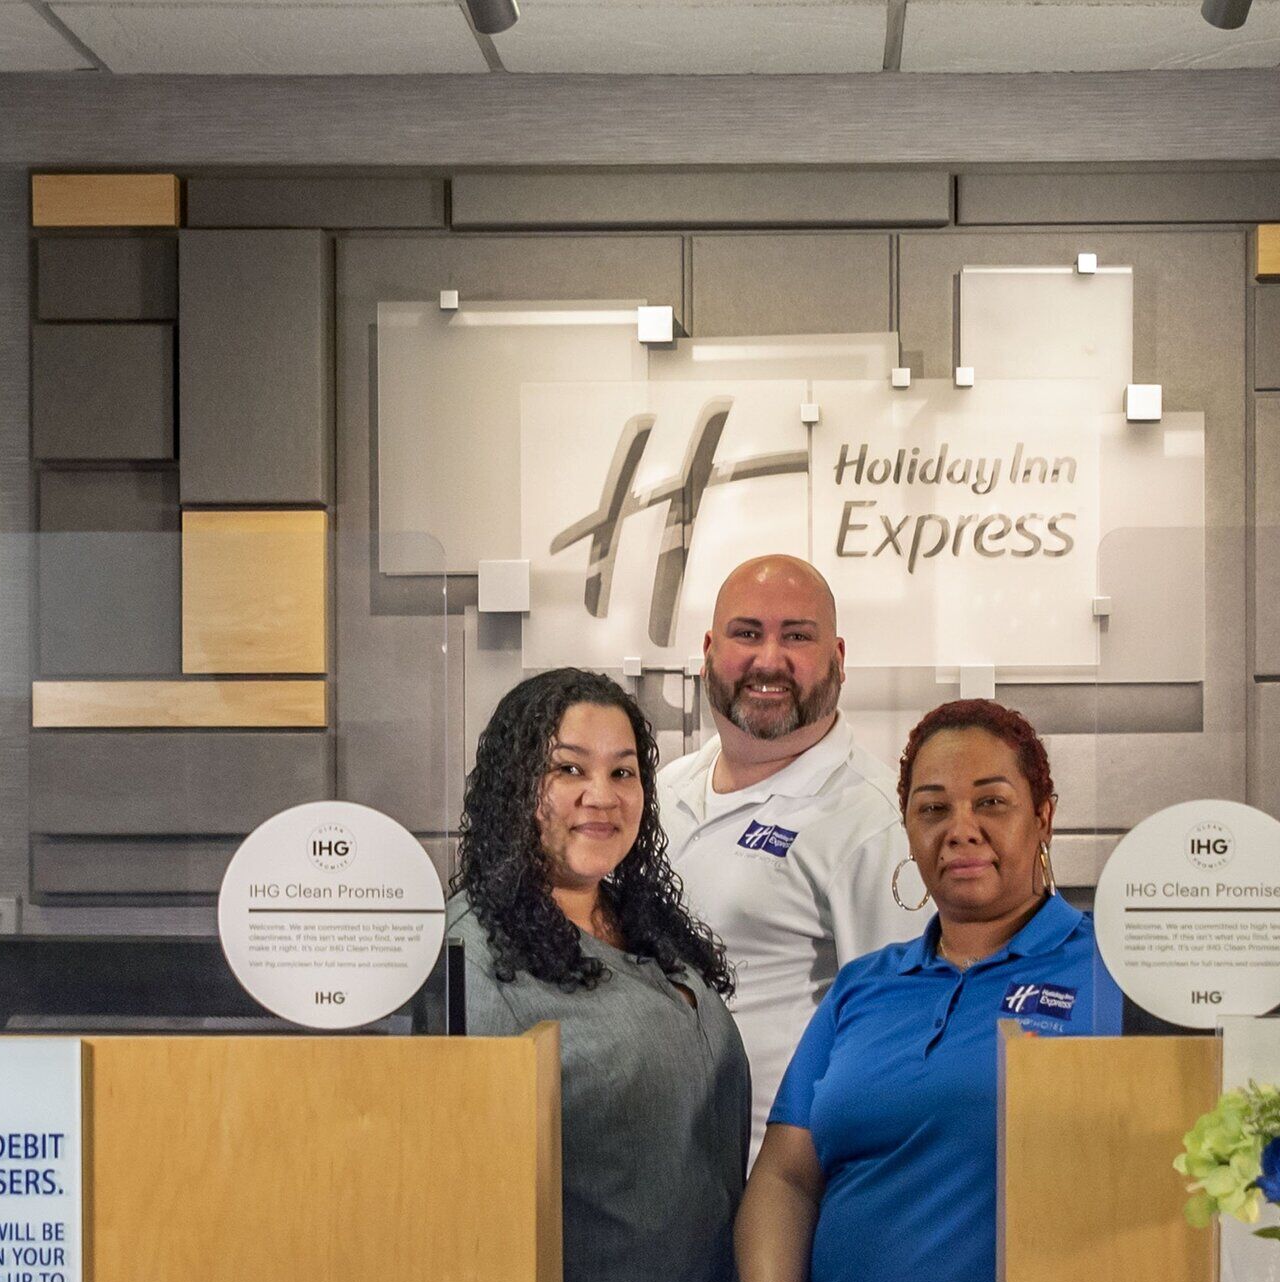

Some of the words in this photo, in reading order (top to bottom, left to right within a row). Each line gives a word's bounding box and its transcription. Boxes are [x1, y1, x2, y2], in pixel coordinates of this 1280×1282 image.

[834, 443, 1002, 495] Holiday
[1009, 442, 1078, 484] Inn
[836, 500, 1077, 575] Express
[312, 841, 350, 856] IHG
[1191, 839, 1228, 854] IHG
[249, 884, 280, 898] IHG
[285, 884, 332, 898] Clean
[338, 885, 404, 899] Promise
[1125, 883, 1157, 897] IHG
[1162, 883, 1210, 897] Clean
[315, 992, 345, 1004] IHG
[1192, 991, 1222, 1004] IHG
[42, 1222, 65, 1241] BE
[13, 1248, 65, 1266] YOUR
